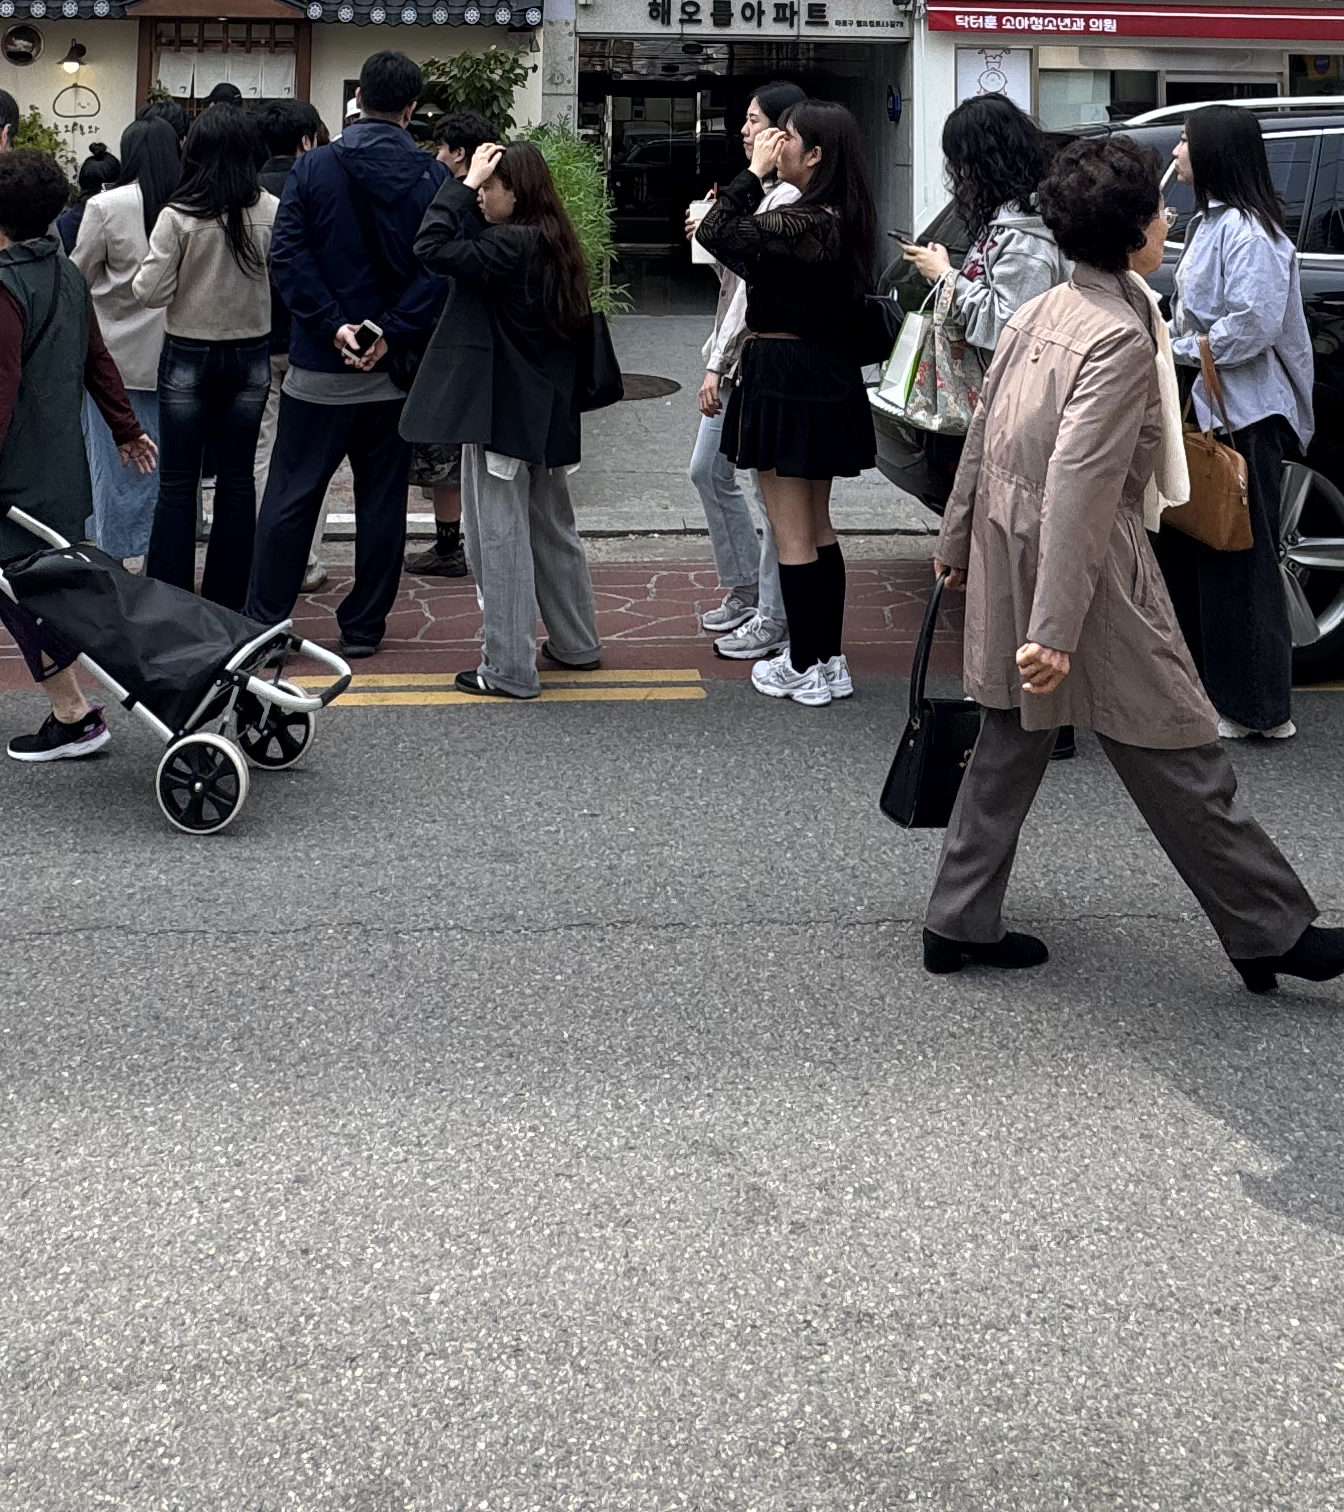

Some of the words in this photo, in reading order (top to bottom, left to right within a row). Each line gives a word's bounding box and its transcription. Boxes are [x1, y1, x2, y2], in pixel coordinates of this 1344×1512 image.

[955, 14, 997, 29] 닥터훈
[1002, 16, 1085, 31] 소아청소년과
[1089, 18, 1117, 33] 의원
